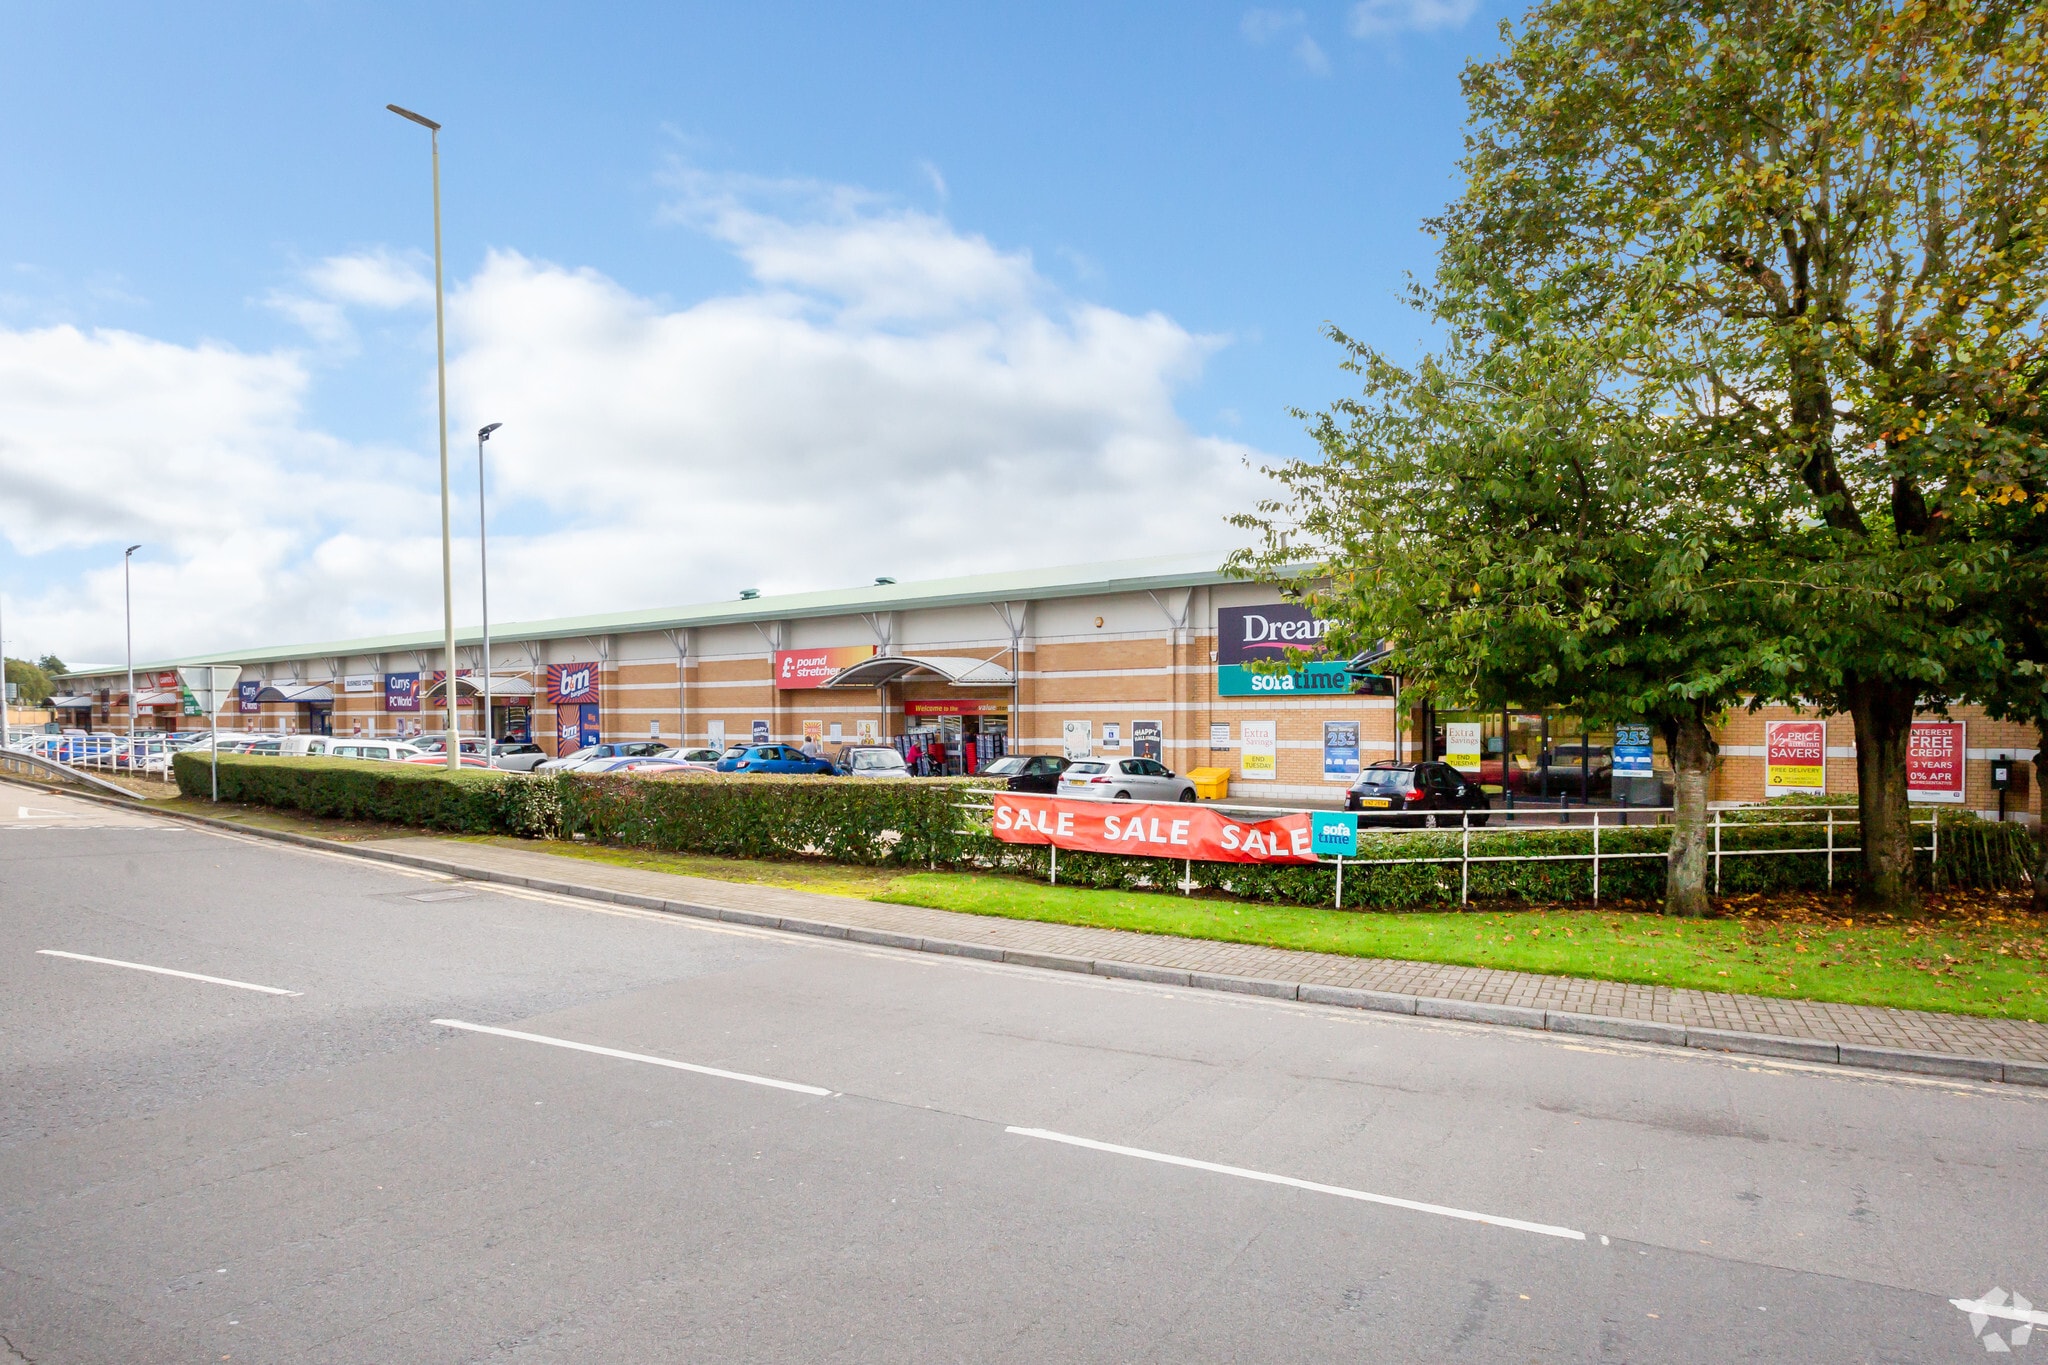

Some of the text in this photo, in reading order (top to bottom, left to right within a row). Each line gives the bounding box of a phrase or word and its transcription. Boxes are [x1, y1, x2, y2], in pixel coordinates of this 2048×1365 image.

[1243, 614, 1350, 643] Dream
[797, 655, 827, 668] pound
[796, 666, 840, 677] stretcher
[391, 676, 410, 691] Currys
[390, 696, 412, 707] PC World
[915, 704, 942, 712] Welcome
[1134, 728, 1158, 736] HAPPY
[1244, 728, 1268, 738] Extra
[1449, 728, 1474, 736] Extra
[1787, 732, 1820, 741] PRICE
[1245, 738, 1273, 747] Savings
[1327, 732, 1356, 746] 25%
[1450, 737, 1479, 745] Savings
[1616, 731, 1650, 745] 25%
[1910, 736, 1953, 748] FREE
[1771, 748, 1820, 758] SAVERS
[1910, 748, 1953, 757] CREDIT
[1910, 772, 1952, 780] 0% APR
[996, 805, 1312, 856] SALE SALE SALE
[1322, 822, 1351, 835] sofa
[1318, 831, 1350, 845] time
